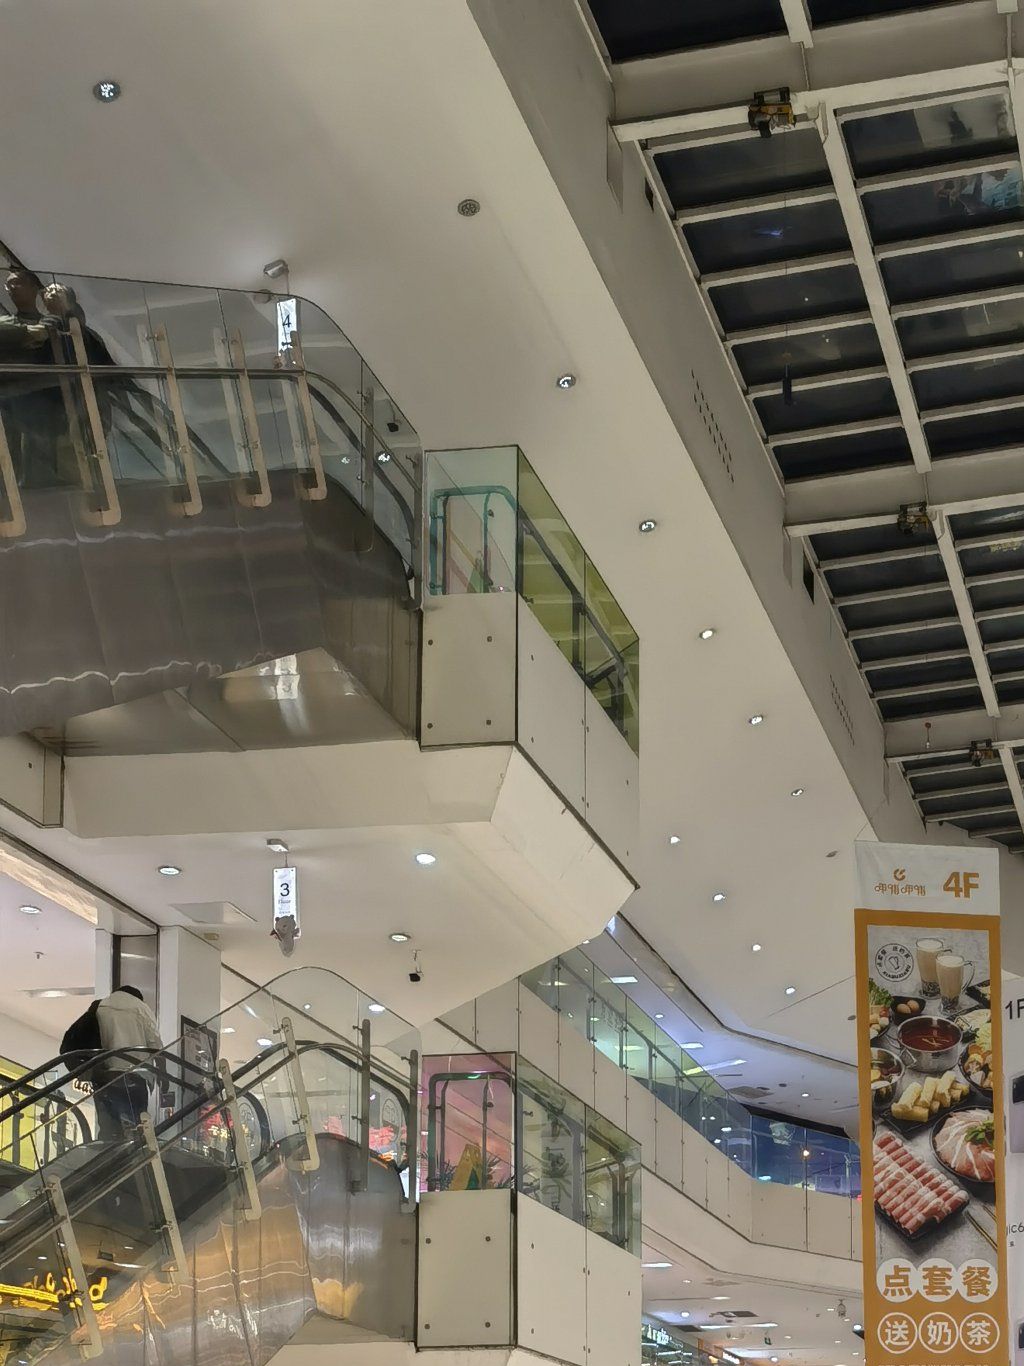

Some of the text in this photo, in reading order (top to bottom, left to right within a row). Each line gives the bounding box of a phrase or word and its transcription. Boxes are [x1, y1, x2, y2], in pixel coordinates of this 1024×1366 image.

[282, 314, 292, 328] 4
[280, 882, 290, 897] 3
[942, 870, 980, 899] 4F
[882, 1264, 992, 1298] 点套餐
[884, 1319, 991, 1347] 送奶茶
